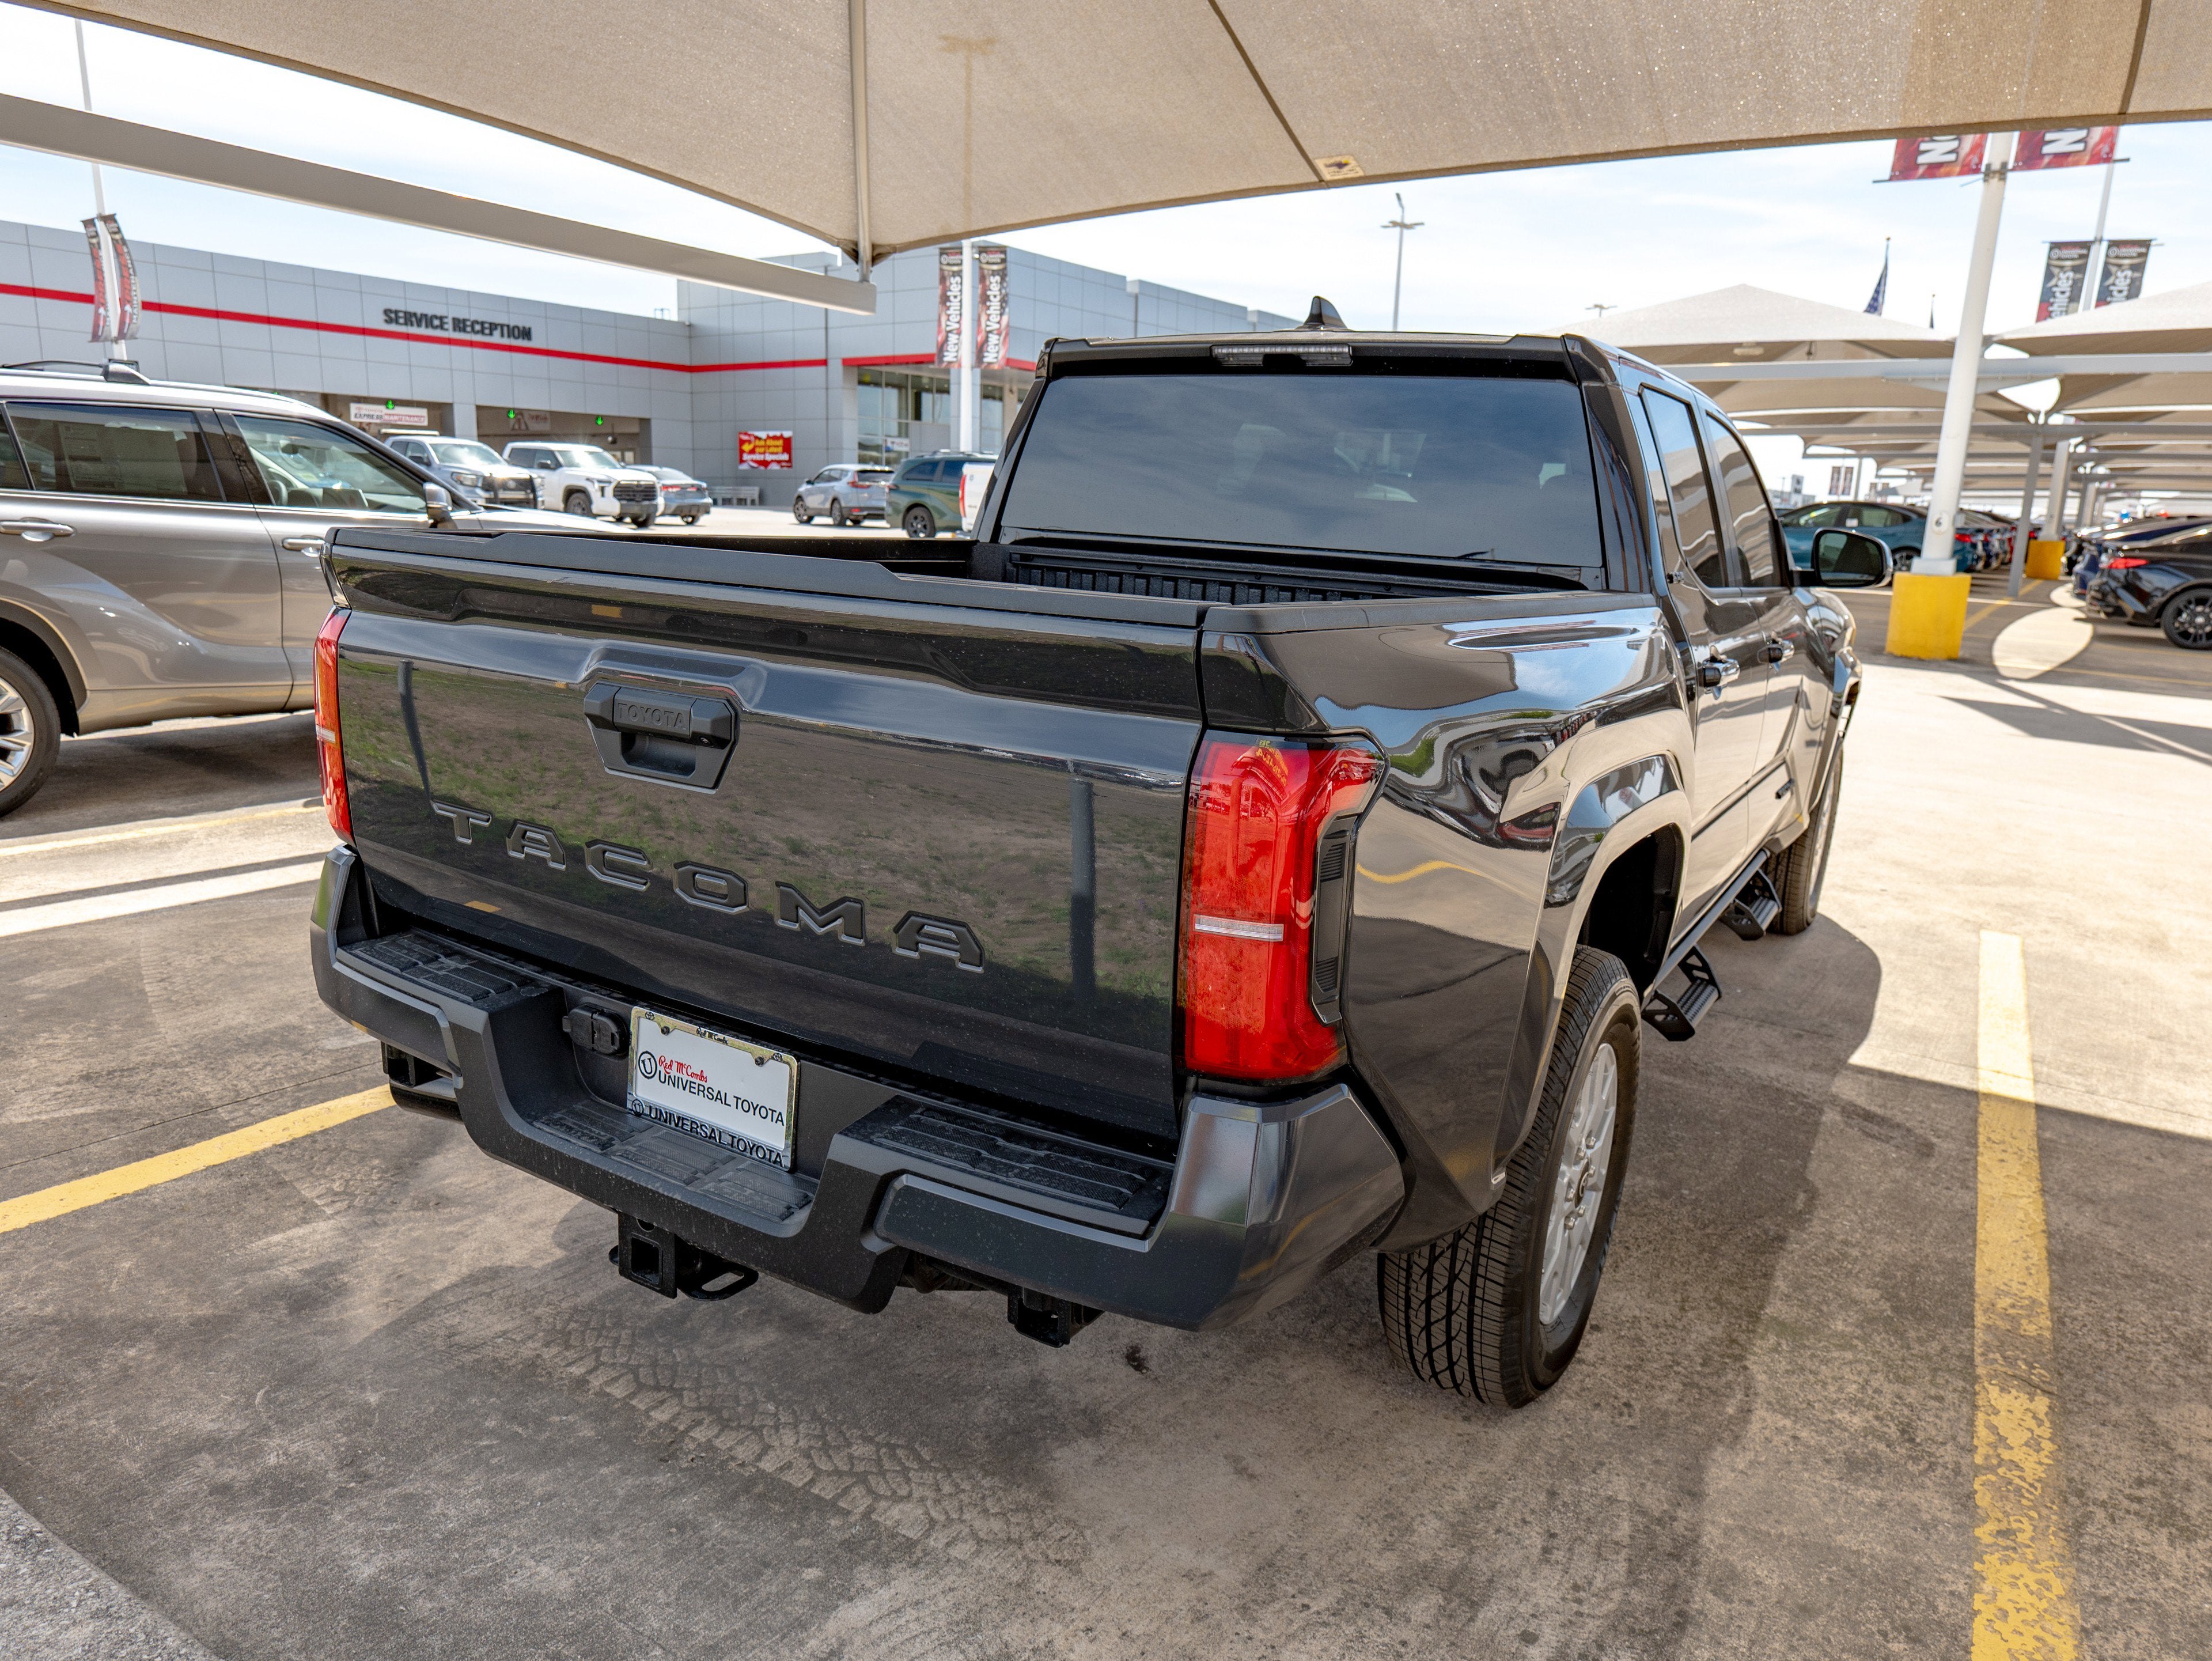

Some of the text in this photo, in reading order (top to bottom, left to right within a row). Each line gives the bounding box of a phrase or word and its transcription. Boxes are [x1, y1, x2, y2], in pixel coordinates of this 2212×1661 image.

[1916, 135, 1959, 164] N
[945, 275, 961, 332] Vehicles
[986, 275, 1002, 332] Vehicles
[383, 309, 532, 341] SERVICE RECEPTION
[943, 333, 961, 363] New
[983, 333, 1001, 364] New
[617, 702, 687, 731] TOYOTA
[430, 800, 984, 973] TACOMA
[658, 1055, 708, 1083] Red McCombs
[658, 1069, 785, 1126] UNIVERSAL TOYOTA
[648, 1105, 728, 1144] UNIVERSAL
[728, 1133, 786, 1168] TOYOTA
